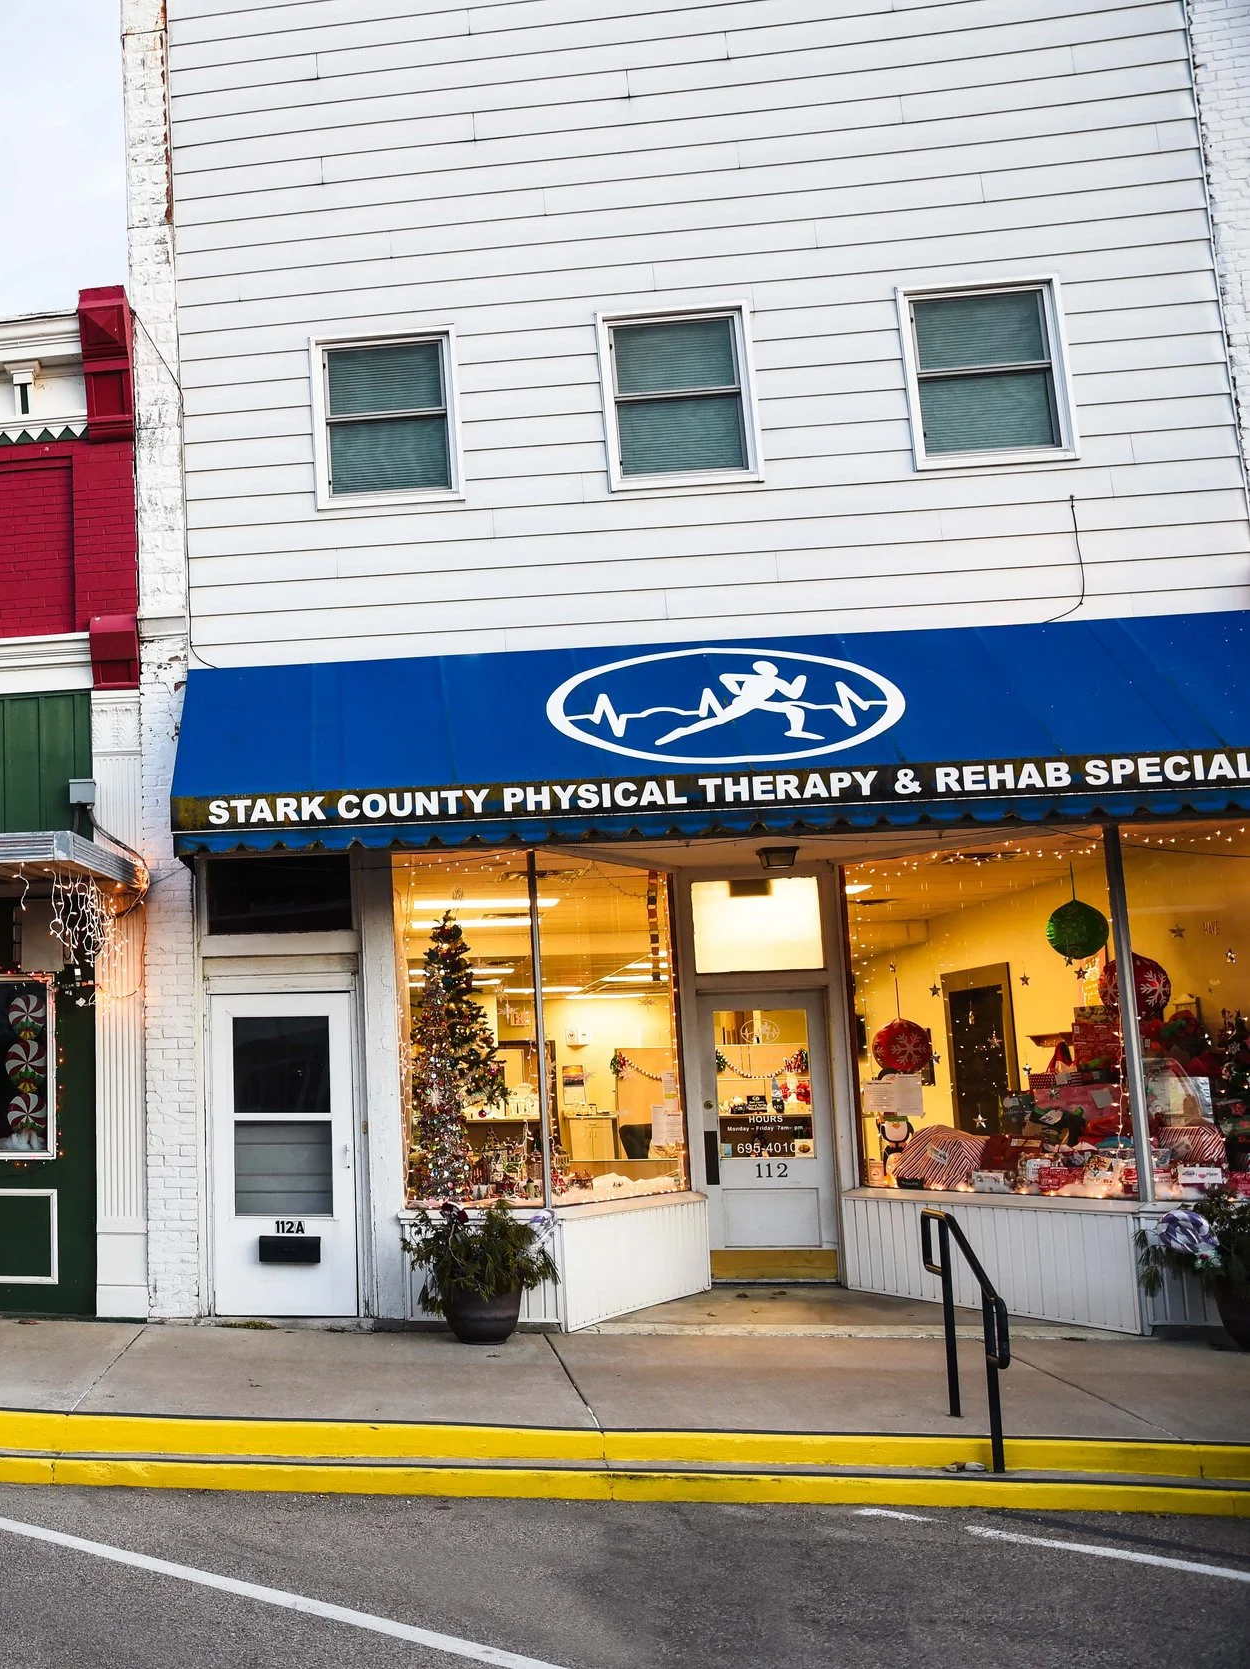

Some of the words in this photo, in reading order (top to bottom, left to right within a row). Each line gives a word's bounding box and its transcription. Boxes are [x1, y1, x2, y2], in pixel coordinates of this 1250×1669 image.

[208, 796, 328, 825] STARK
[337, 788, 490, 820] COUNTY
[503, 780, 688, 812] PHYSICAL
[698, 769, 879, 803] THERAPY
[894, 768, 922, 794] &
[936, 761, 1072, 793] REHAB
[1084, 753, 1250, 787] SPECIAL
[748, 1115, 783, 1123] HOURS
[737, 1142, 795, 1154] 695-4010
[756, 1162, 788, 1178] 112
[275, 1220, 305, 1234] 112A
